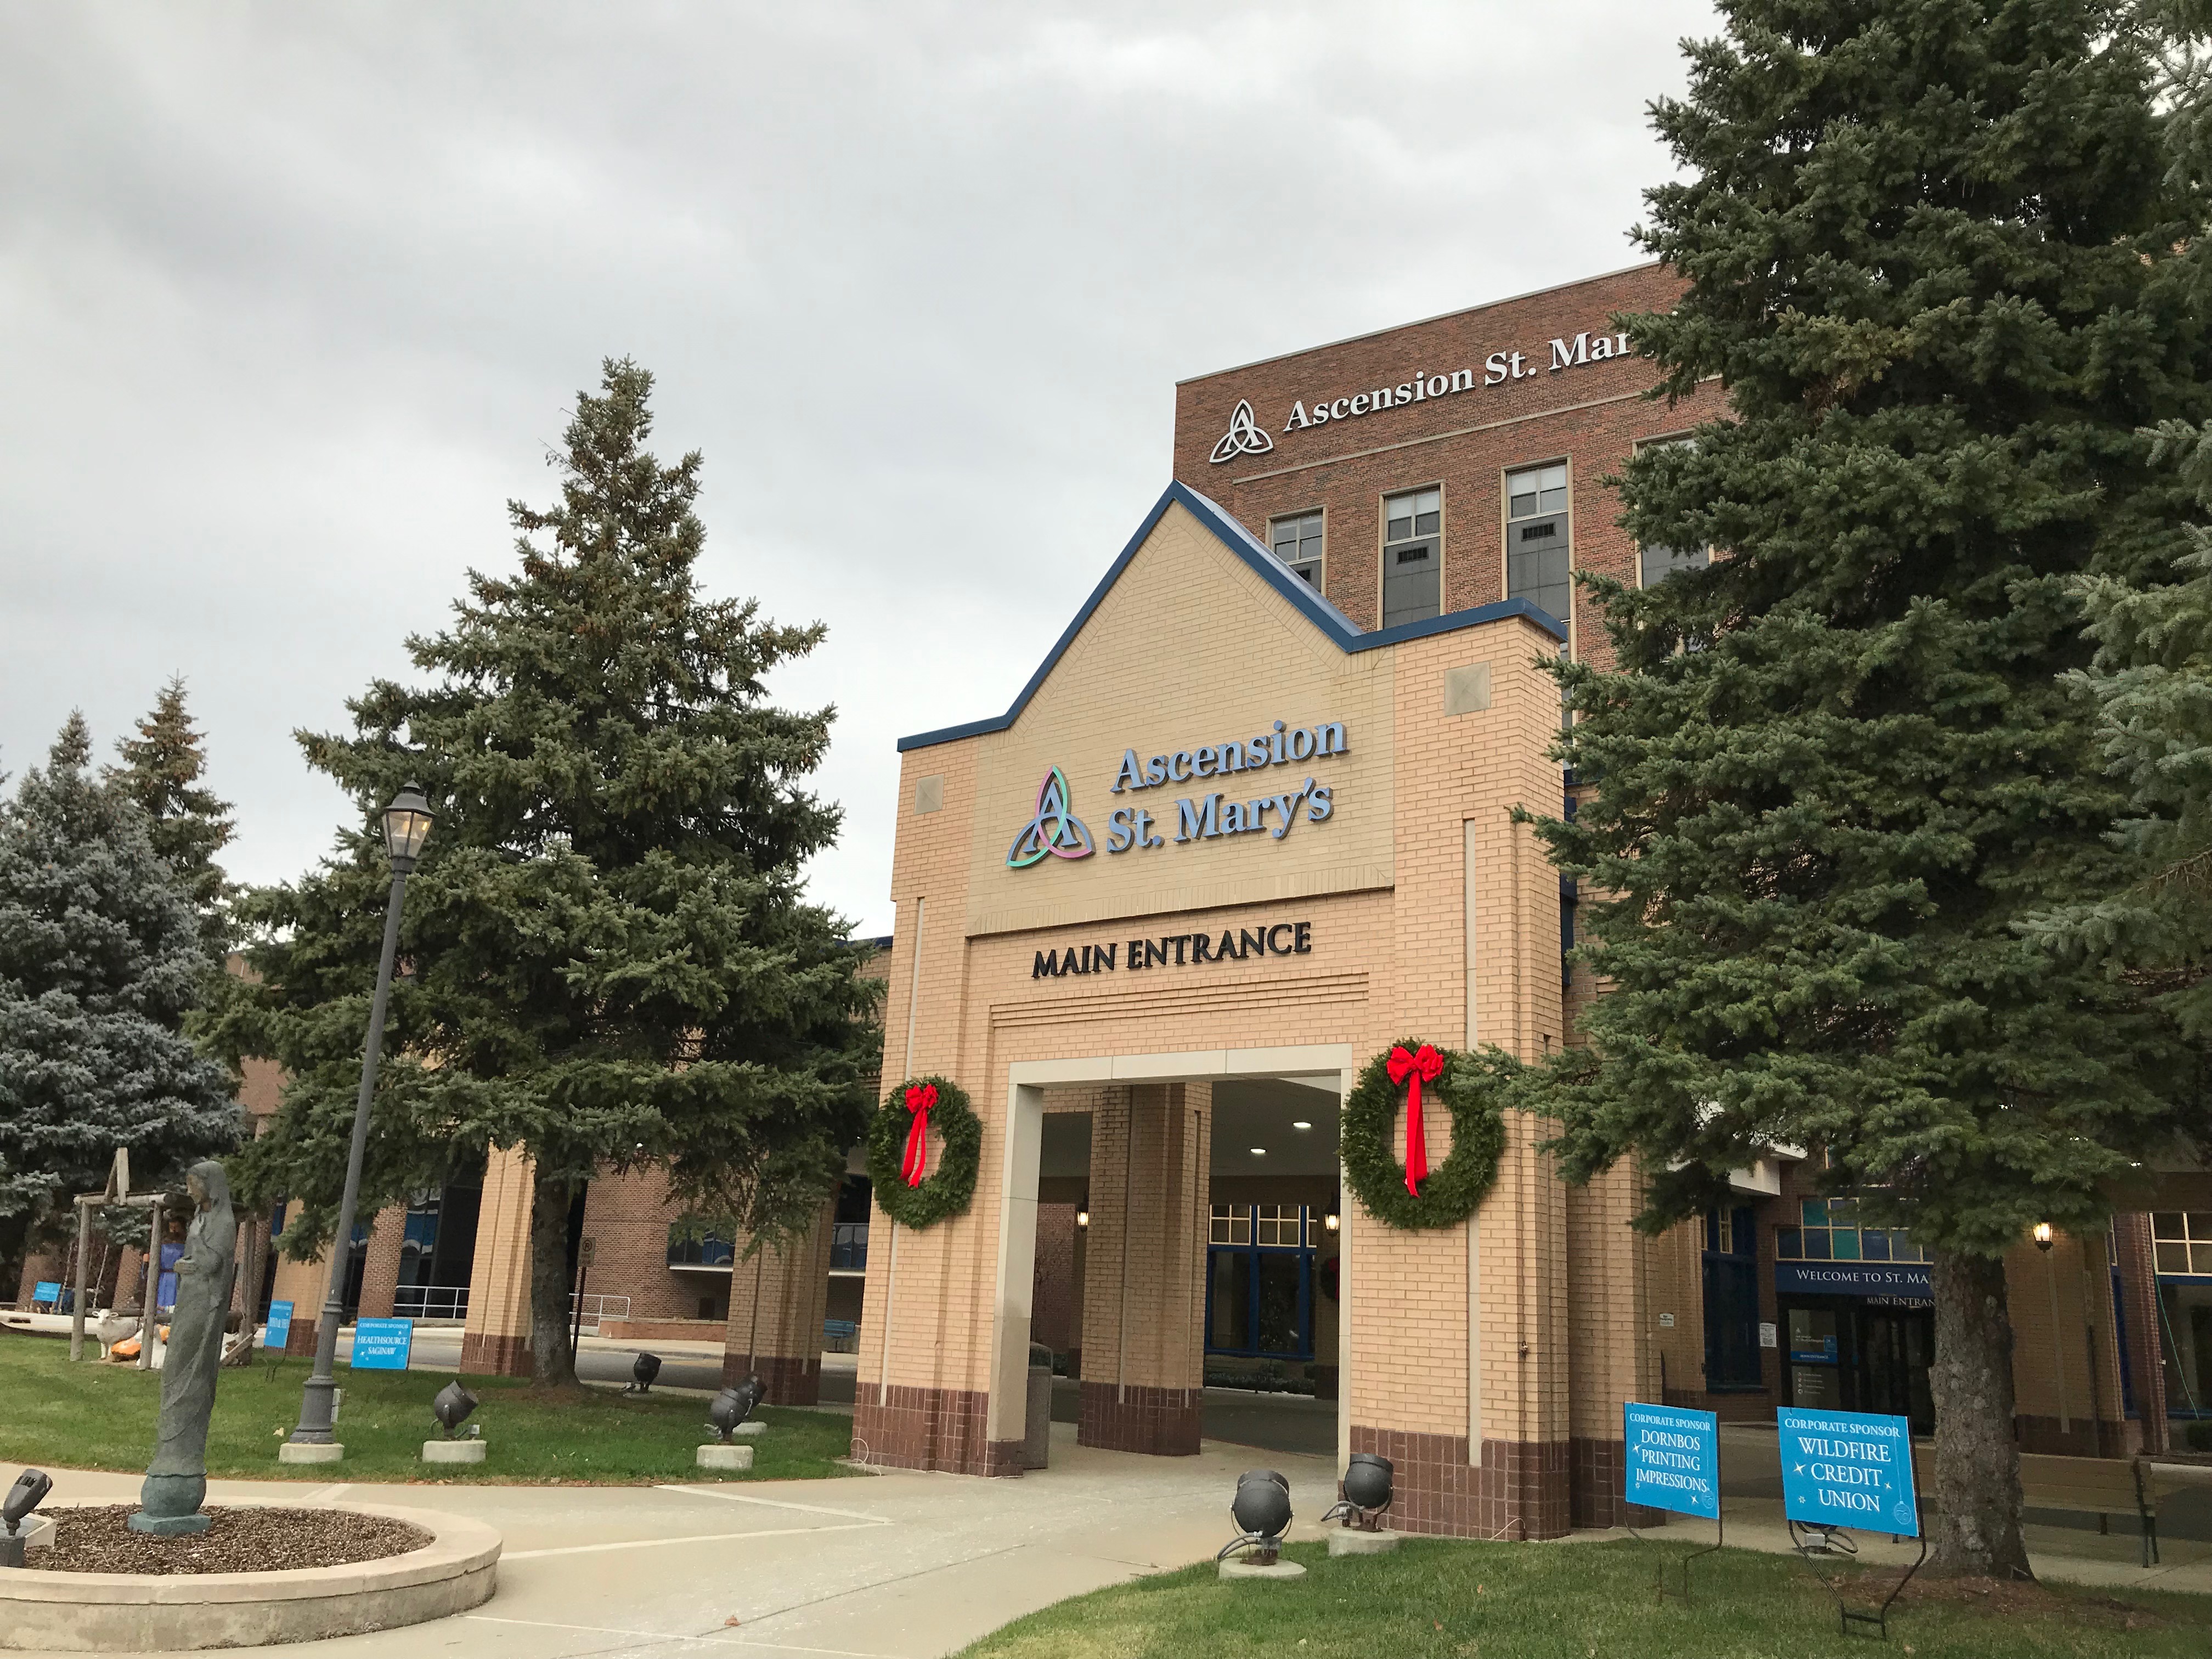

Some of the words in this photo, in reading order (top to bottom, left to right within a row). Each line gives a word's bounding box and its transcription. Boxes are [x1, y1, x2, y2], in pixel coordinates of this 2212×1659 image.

[1283, 371, 1475, 433] Ascension
[1484, 351, 1537, 386] St.
[1548, 330, 1655, 370] Mar
[1110, 720, 1350, 794] Ascension
[1106, 807, 1165, 854] St.
[1173, 777, 1334, 840] Mary's
[1031, 942, 1118, 979] MAIN
[1126, 921, 1312, 970] ENTRANCE
[1796, 1269, 1859, 1282] WELCOME
[1863, 1272, 1881, 1283] TO
[1885, 1271, 1903, 1283] ST.
[1867, 1296, 1889, 1305] MAIN
[1893, 1297, 1936, 1307] ENTRAN
[357, 1335, 407, 1345] HEALTHSOURCE
[368, 1347, 397, 1355] SAGINAW
[1629, 1413, 1674, 1427] CORPORATE
[1675, 1418, 1711, 1431] SPONSOR
[1785, 1418, 1848, 1433] CORPORATE
[1849, 1423, 1901, 1438] SPONSOR
[1641, 1429, 1700, 1451] DORNBOS
[1797, 1436, 1891, 1462] WILDFIRE
[1641, 1448, 1700, 1471] PRINTING
[1636, 1468, 1707, 1493] IMPRESSIONS
[1811, 1463, 1882, 1487] CREDIT
[1818, 1488, 1880, 1512] UNION
